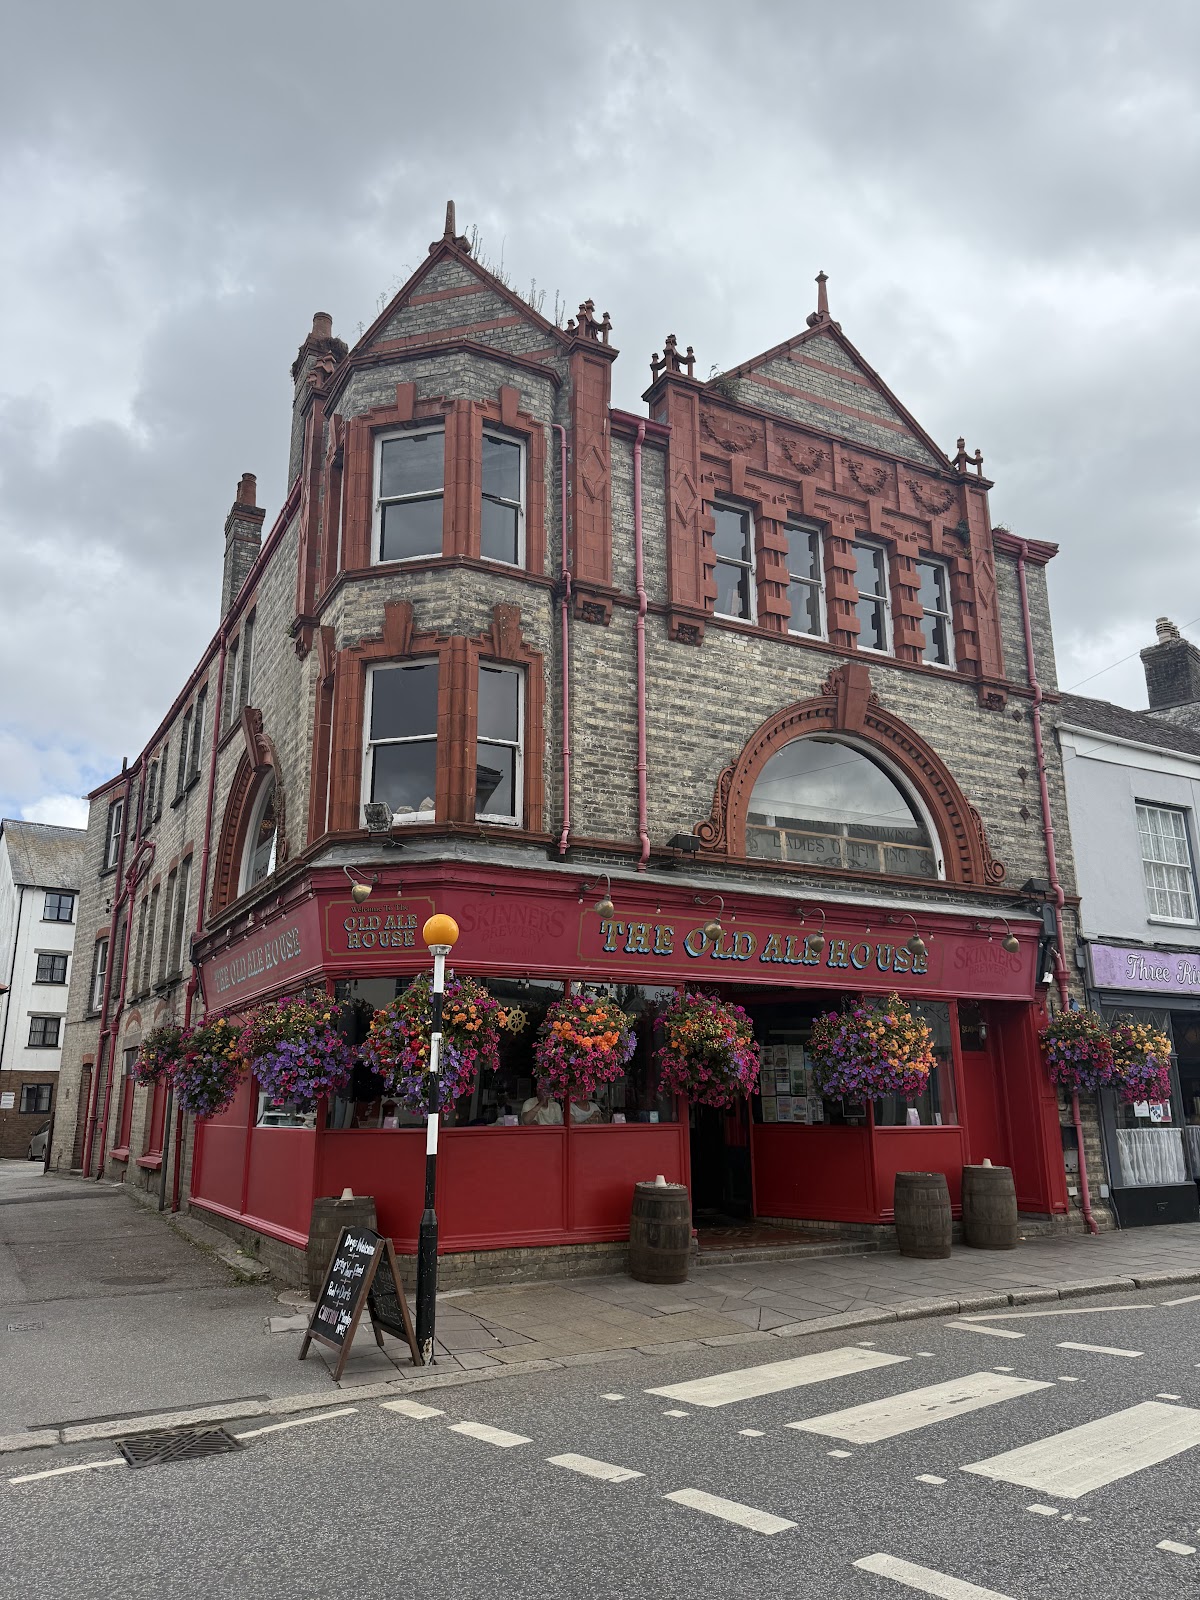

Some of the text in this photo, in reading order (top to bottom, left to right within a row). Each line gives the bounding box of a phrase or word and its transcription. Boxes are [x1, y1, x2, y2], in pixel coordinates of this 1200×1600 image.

[773, 834, 825, 853] LADIES
[350, 903, 410, 914] Welcome To The
[343, 913, 418, 932] OLD ALE
[347, 930, 416, 949] HOUSE
[480, 925, 545, 943] BREWERY
[599, 919, 929, 975] THE OLD ALE HOUSE
[214, 926, 302, 994] THE OLD ALE HOUSE
[969, 962, 1009, 977] BREWERY
[1125, 953, 1172, 983] Three
[344, 1233, 375, 1256] Dogs Welcome
